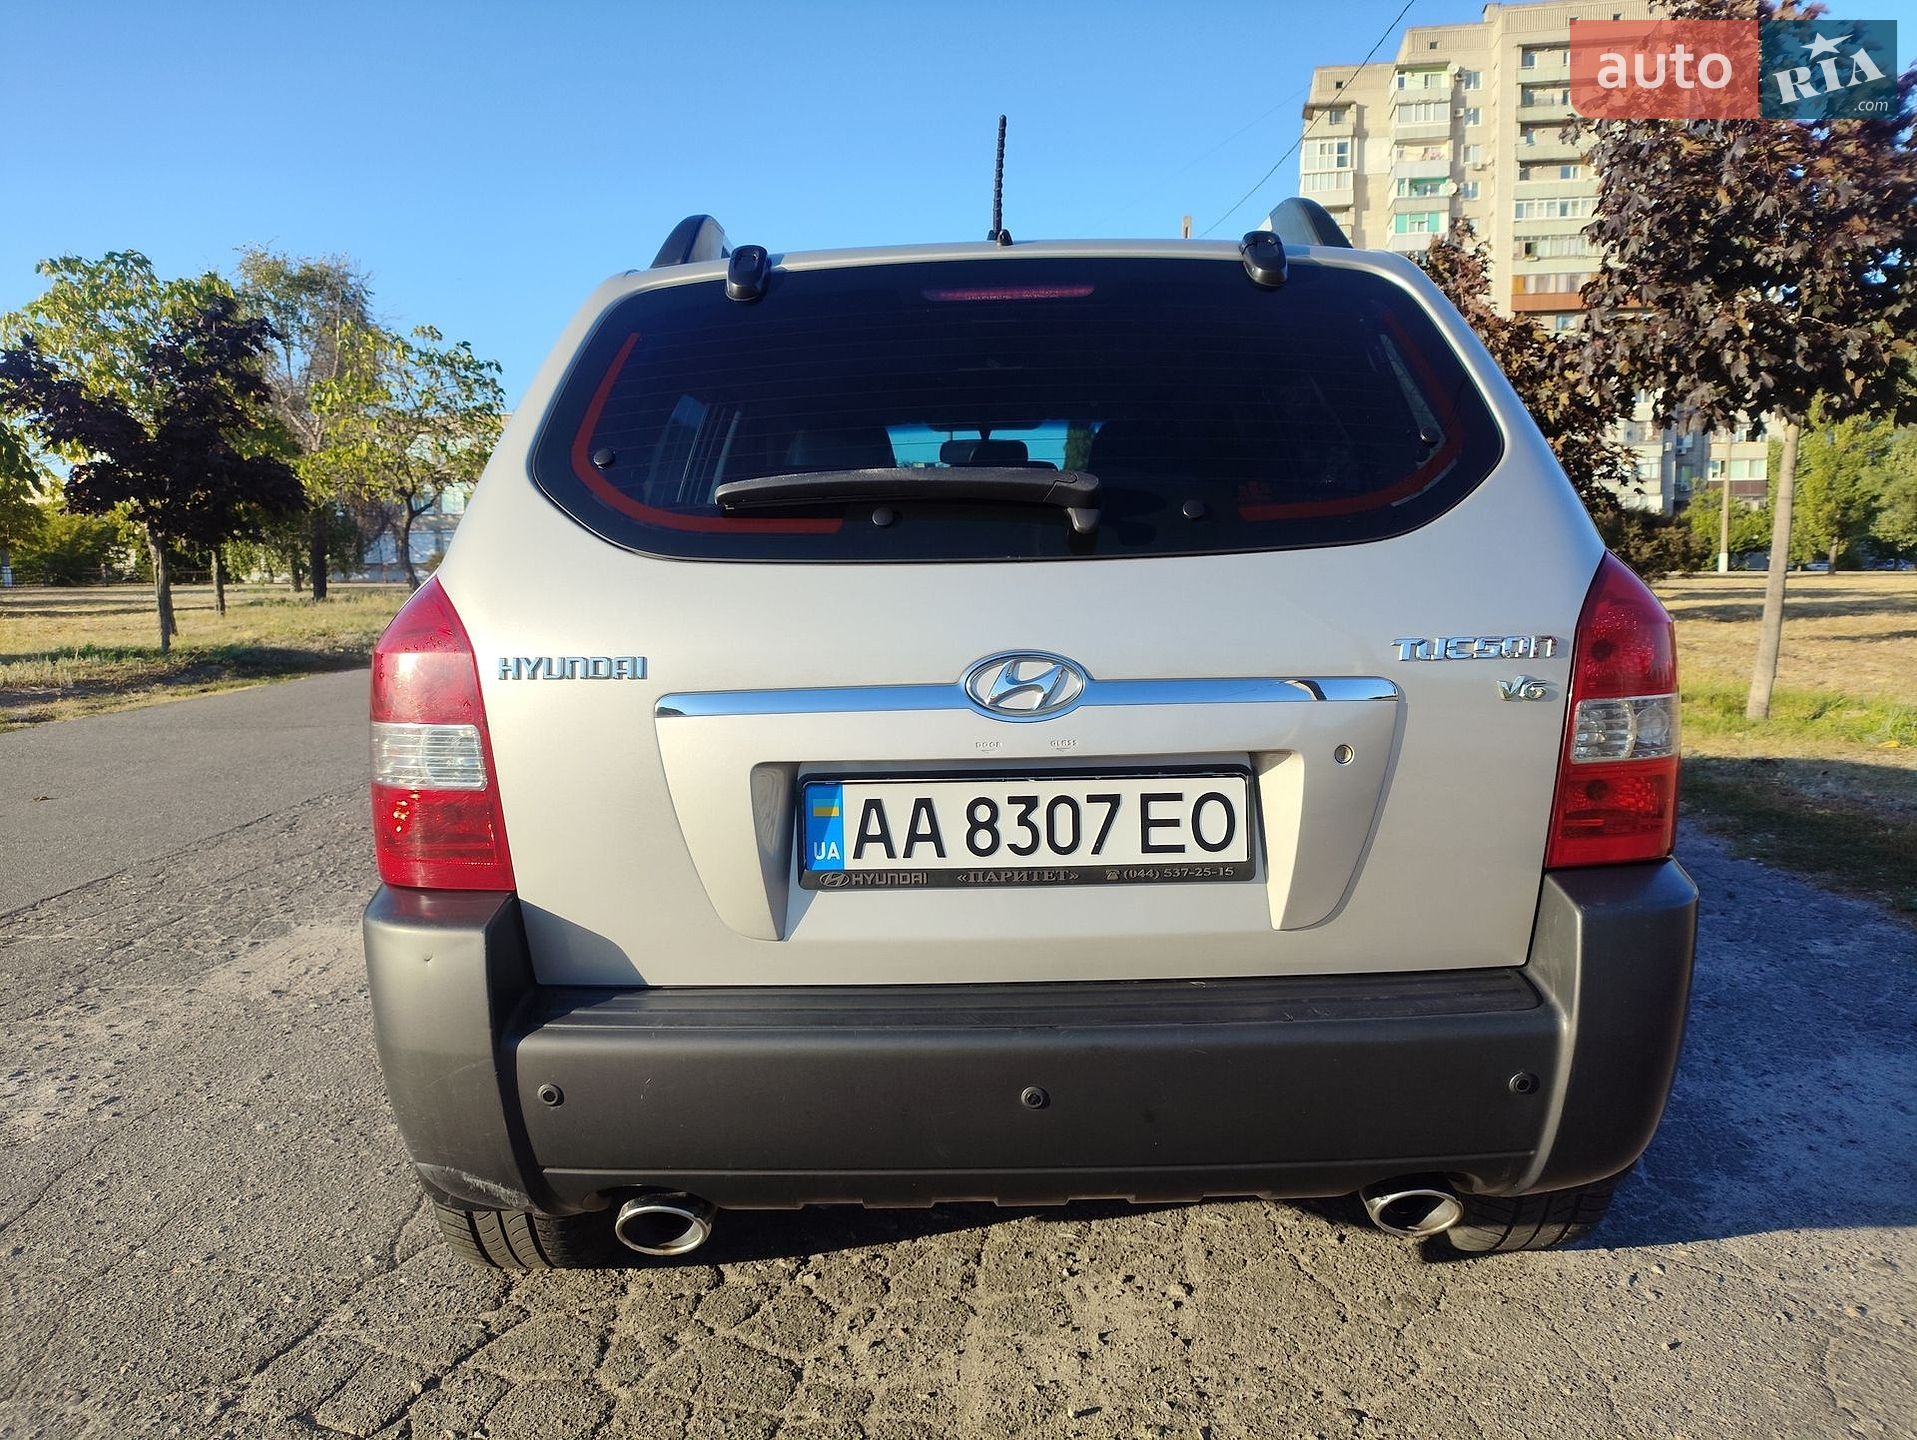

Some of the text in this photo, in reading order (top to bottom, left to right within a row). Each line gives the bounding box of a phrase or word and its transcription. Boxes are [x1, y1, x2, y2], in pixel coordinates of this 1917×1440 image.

[1391, 634, 1558, 662] TUCSON
[498, 655, 648, 681] HYUNDAI
[1496, 674, 1548, 702] V6
[852, 791, 1237, 861] AA 8307 EO
[812, 841, 842, 862] UA
[851, 872, 929, 887] HYUNDAI
[1123, 865, 1235, 880] (044) 537-25-15
